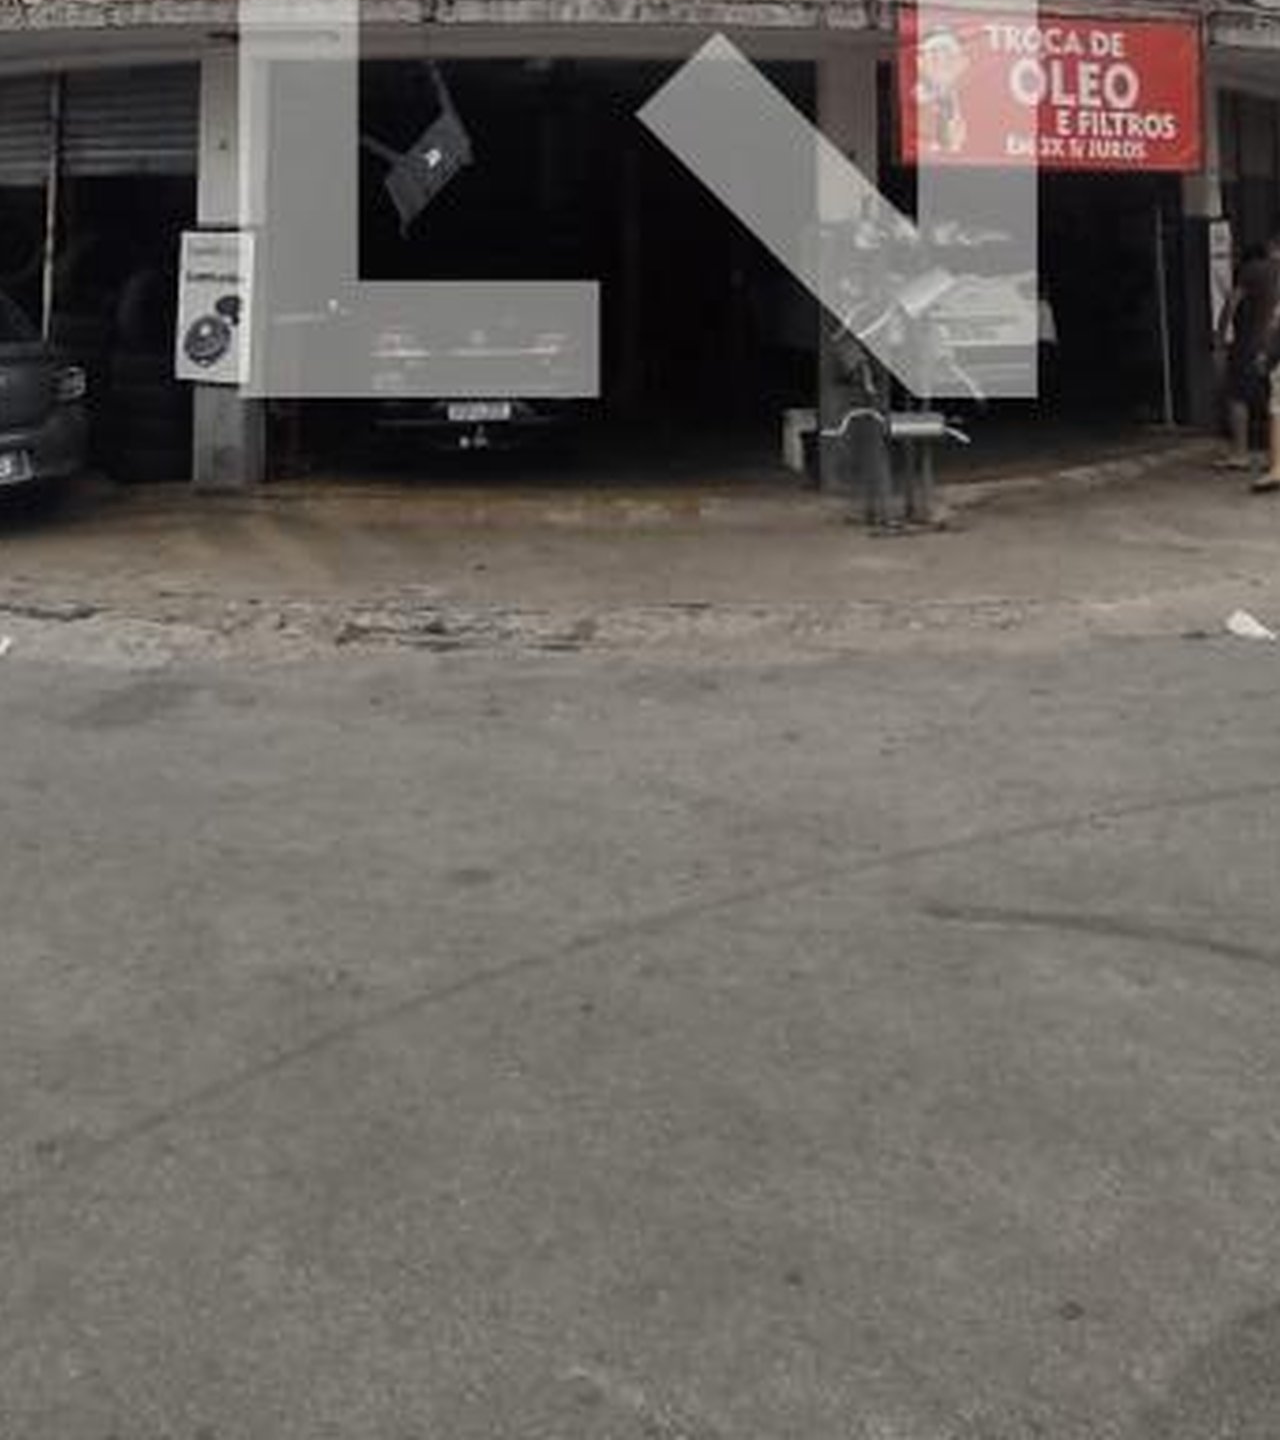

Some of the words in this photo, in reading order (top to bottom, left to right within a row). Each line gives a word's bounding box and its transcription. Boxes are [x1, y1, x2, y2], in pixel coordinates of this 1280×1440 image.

[983, 24, 1083, 56] TROCA
[1091, 30, 1125, 58] DE
[1056, 112, 1072, 136] E
[1078, 112, 1177, 140] FILTROS
